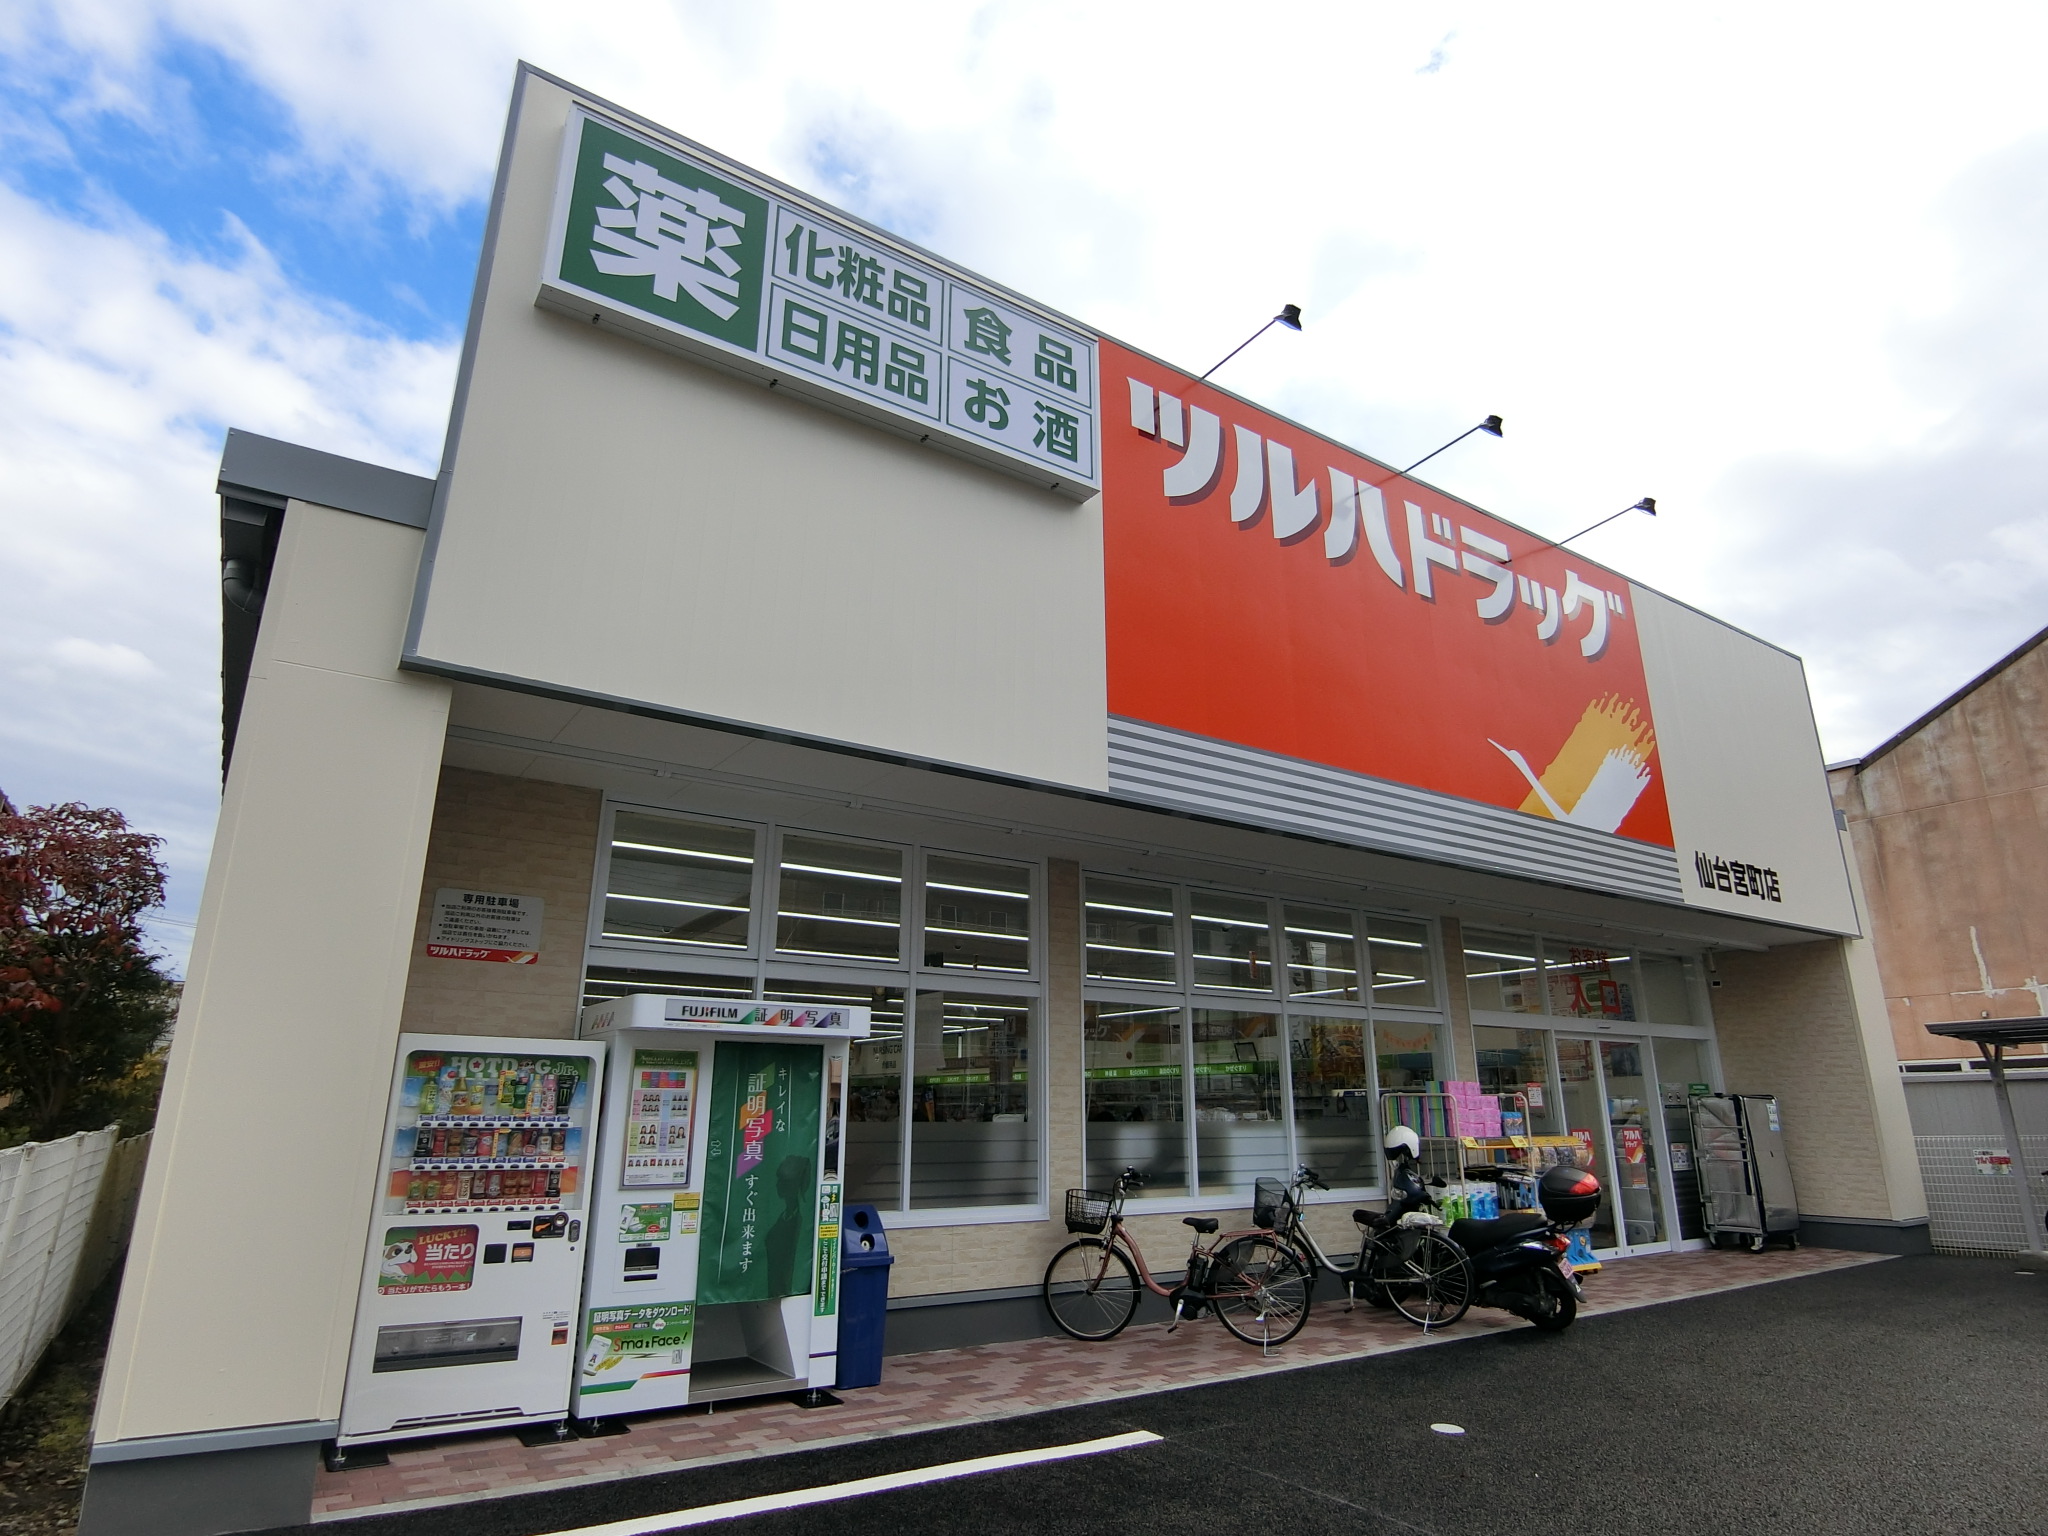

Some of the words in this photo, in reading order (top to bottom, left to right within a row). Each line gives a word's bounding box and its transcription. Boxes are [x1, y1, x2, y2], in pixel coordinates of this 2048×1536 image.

[590, 152, 746, 321] 薬
[785, 223, 931, 332] 化粧品
[782, 299, 929, 405] 日用品
[964, 306, 1078, 393] 食品
[964, 378, 1079, 463] お酒
[1127, 377, 1625, 657] ツルハドラッグ
[463, 894, 519, 908] 専用駐車場
[1695, 850, 1781, 903] 仙台宮町店
[430, 946, 491, 958] ツルハドラッグ
[1568, 946, 1611, 972] お客様
[682, 1005, 738, 1019] FUJIFILM
[754, 1007, 842, 1027] 証明写真
[1570, 975, 1623, 1015] 入口
[451, 1056, 551, 1078] HOTDG
[552, 1061, 579, 1076] Jr.
[743, 1073, 767, 1161] 証明写真
[776, 1067, 788, 1132] キレイな
[418, 1228, 467, 1245] LUCKY!!
[739, 1174, 759, 1274] すぐ出来ます
[425, 1242, 475, 1261] 当たり
[593, 1304, 692, 1323] 証明写真データをダウンロード!
